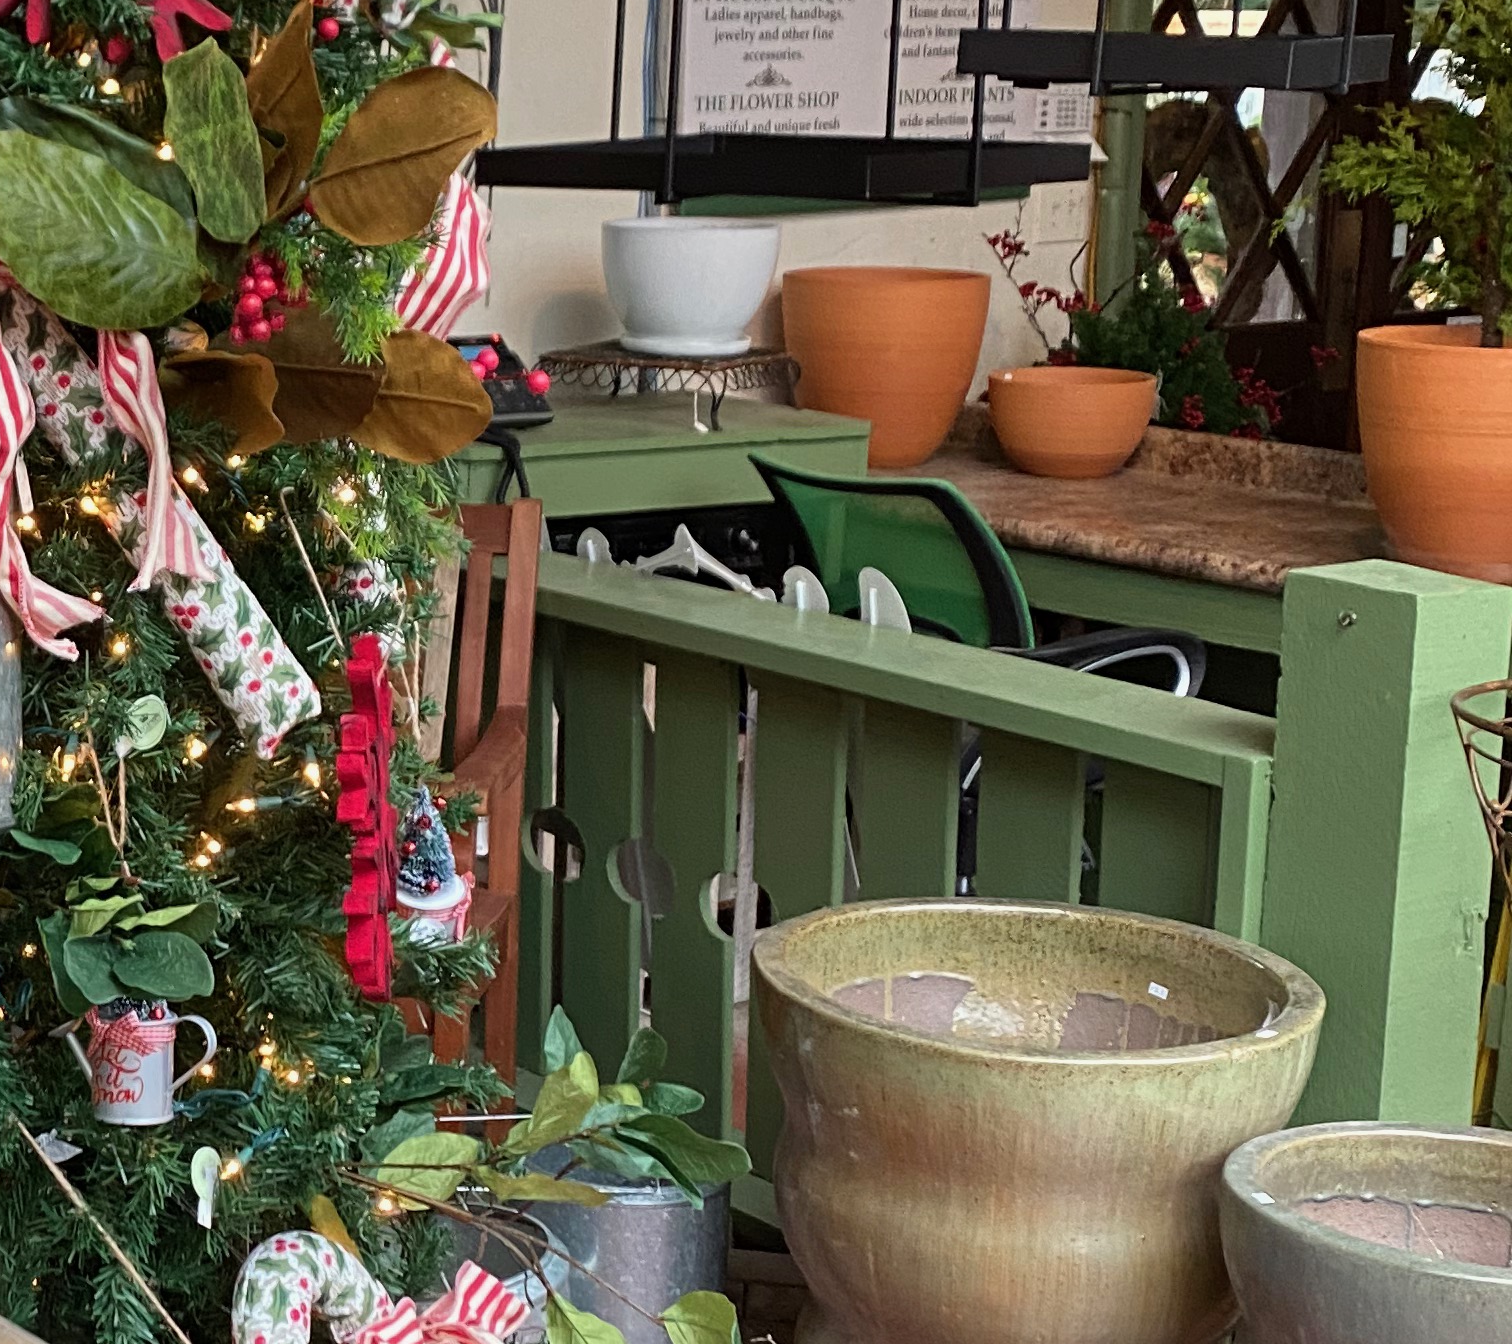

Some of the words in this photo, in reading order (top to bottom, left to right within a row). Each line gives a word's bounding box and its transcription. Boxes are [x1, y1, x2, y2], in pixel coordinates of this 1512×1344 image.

[714, 26, 755, 45] jewelry
[758, 26, 780, 41] and
[782, 26, 810, 41] other
[813, 24, 835, 40] fine
[695, 94, 727, 112] THE
[730, 92, 794, 110] FLOWER
[797, 90, 840, 107] SHOP
[898, 87, 958, 105] INDOOR
[962, 86, 1015, 102] PLNTS
